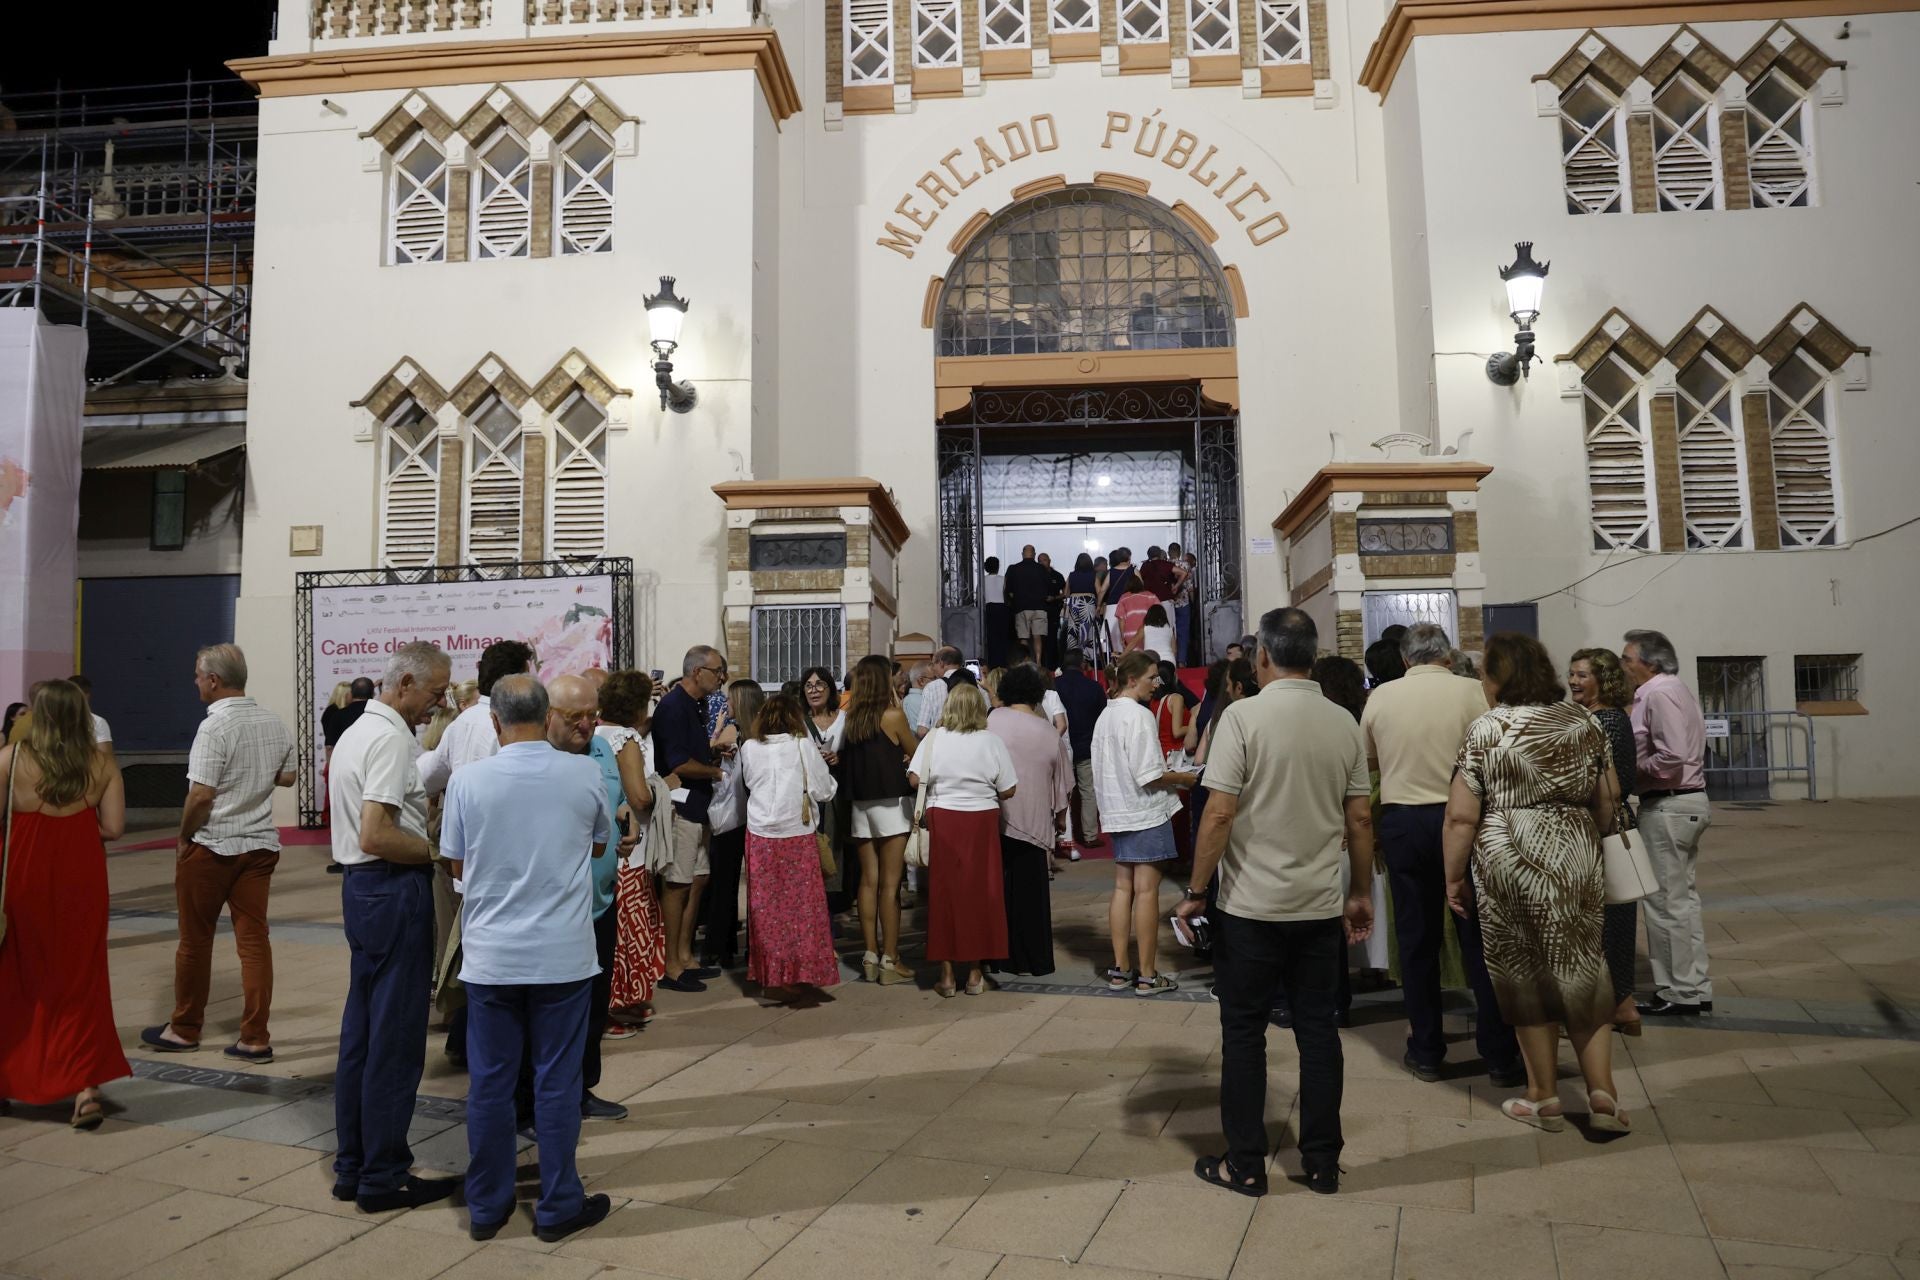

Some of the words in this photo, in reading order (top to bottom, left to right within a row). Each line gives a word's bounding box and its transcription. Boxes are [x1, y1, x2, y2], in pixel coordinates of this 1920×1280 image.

[876, 112, 1059, 259] MERCADO
[1100, 107, 1290, 246] PÚBLICO
[383, 625, 410, 634] Festival
[411, 624, 456, 633] Internacional
[320, 637, 379, 656] Cante
